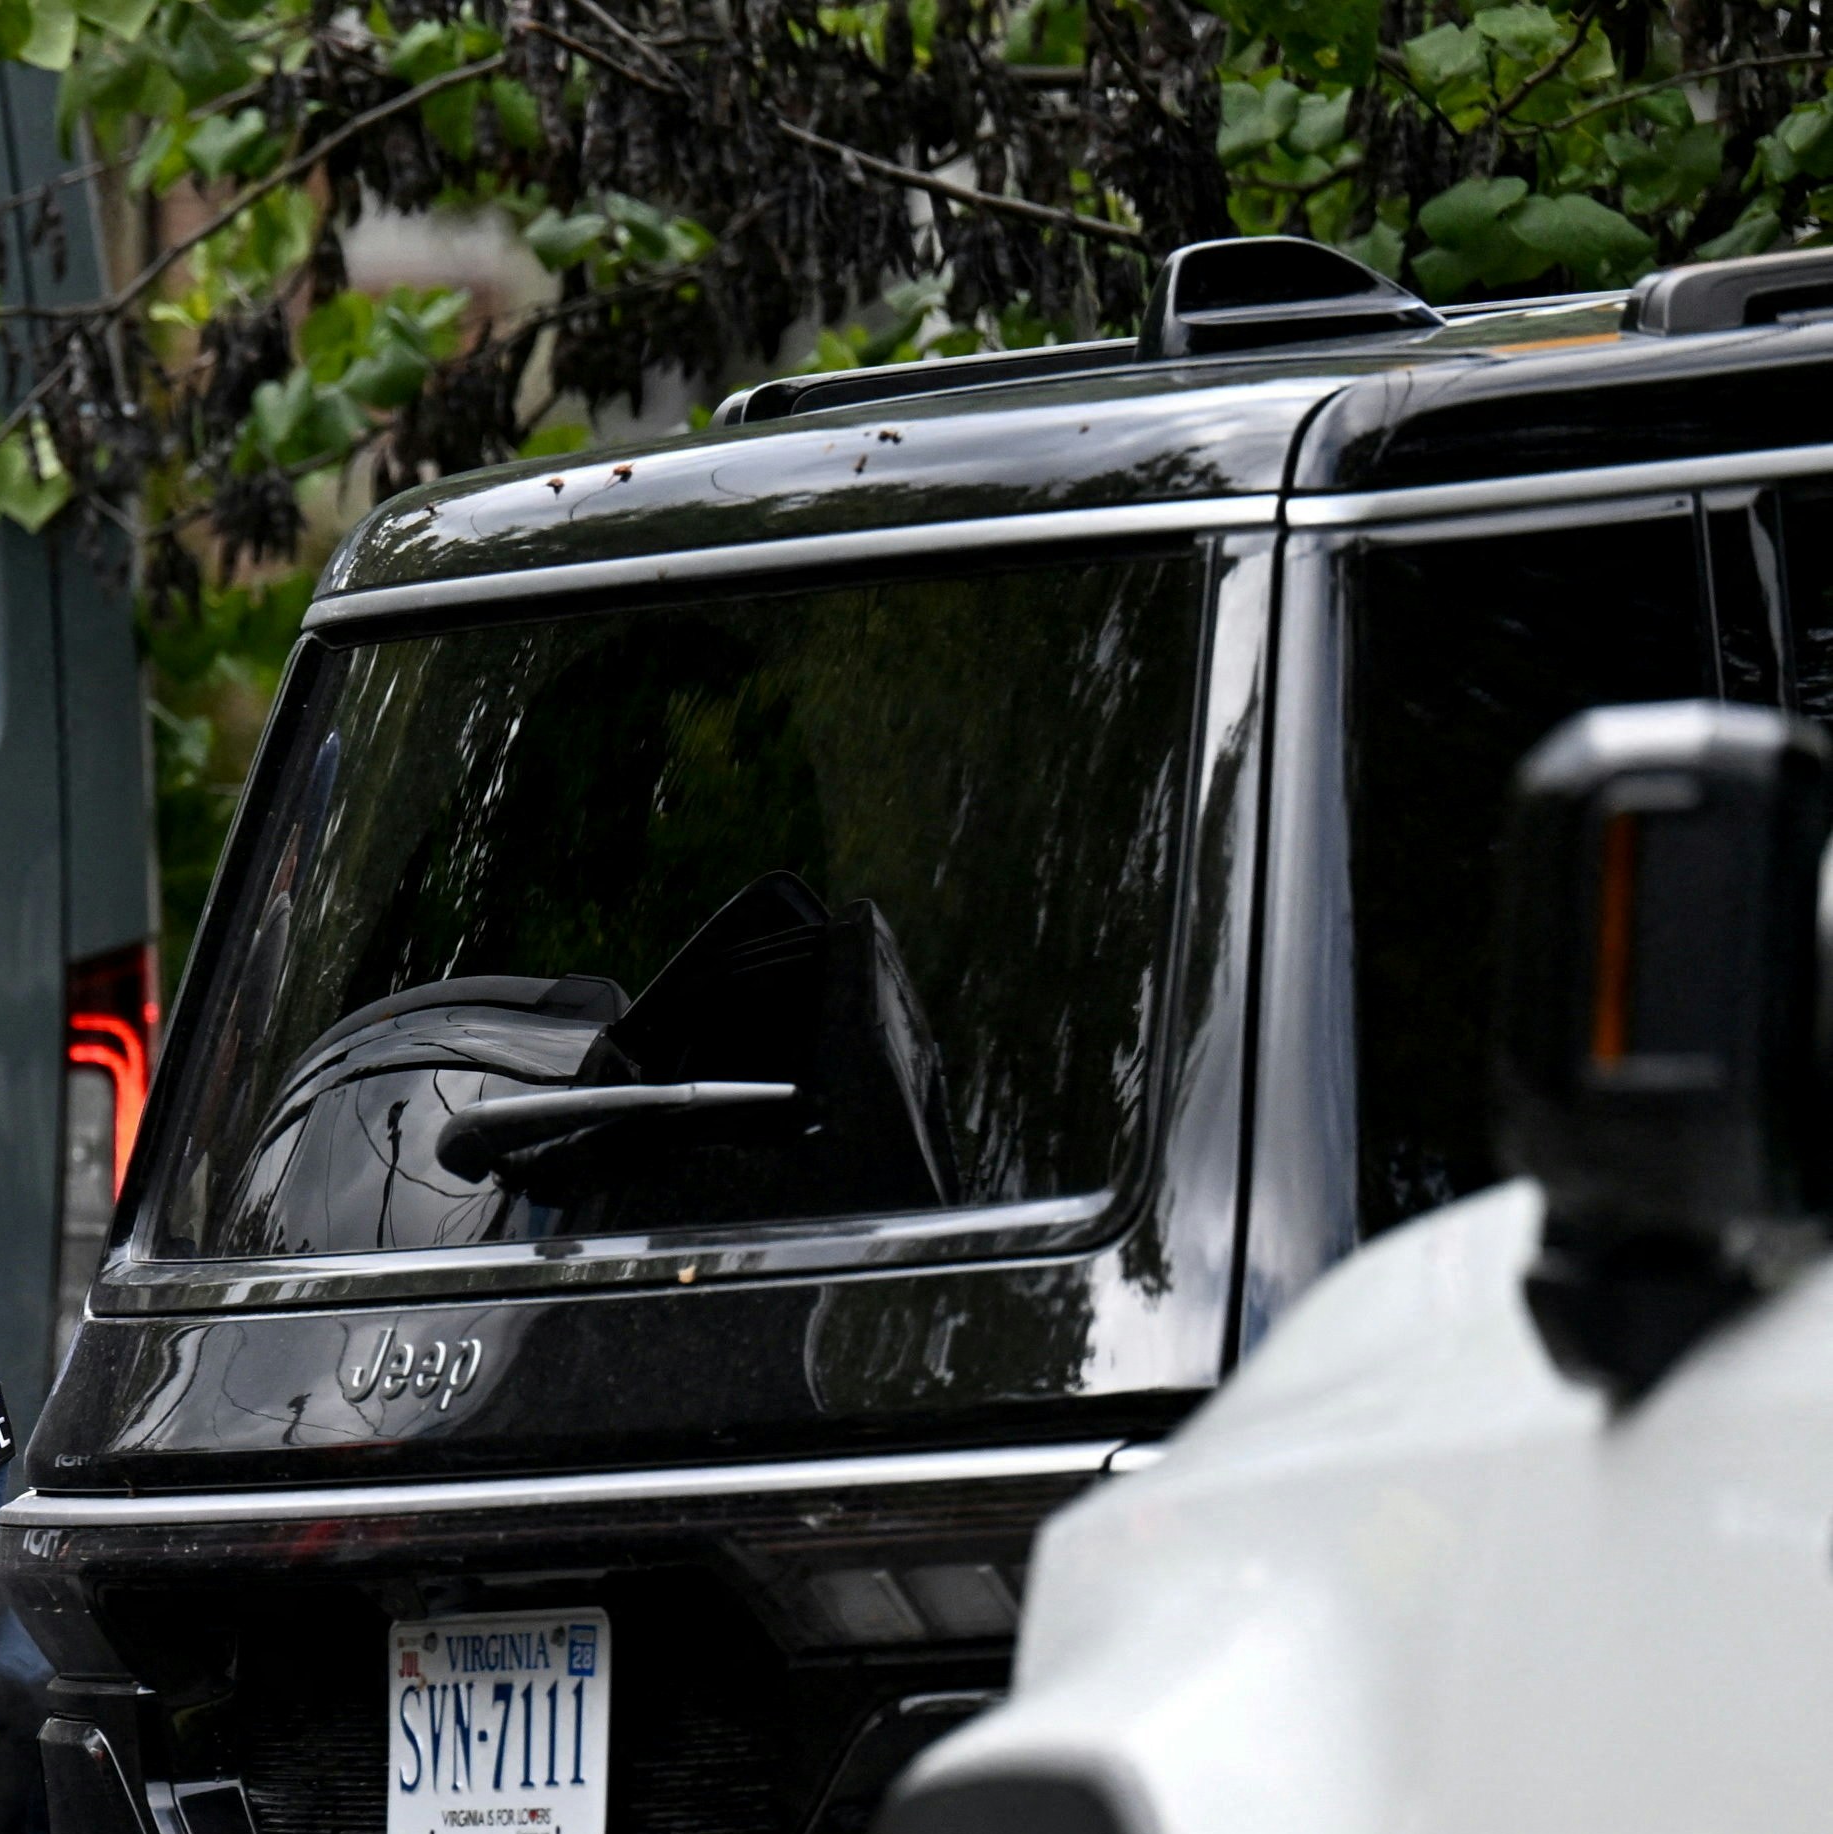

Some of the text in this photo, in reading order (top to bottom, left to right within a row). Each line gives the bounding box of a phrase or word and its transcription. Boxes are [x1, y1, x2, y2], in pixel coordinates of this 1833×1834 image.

[345, 1327, 482, 1411] Jeep
[398, 1651, 421, 1679] JUL
[446, 1631, 551, 1673] VIRGINIA
[399, 1679, 585, 1793] SVN-7111
[442, 1809, 485, 1828] VIRGINIA
[486, 1809, 495, 1827] IS
[496, 1808, 514, 1826] FOR
